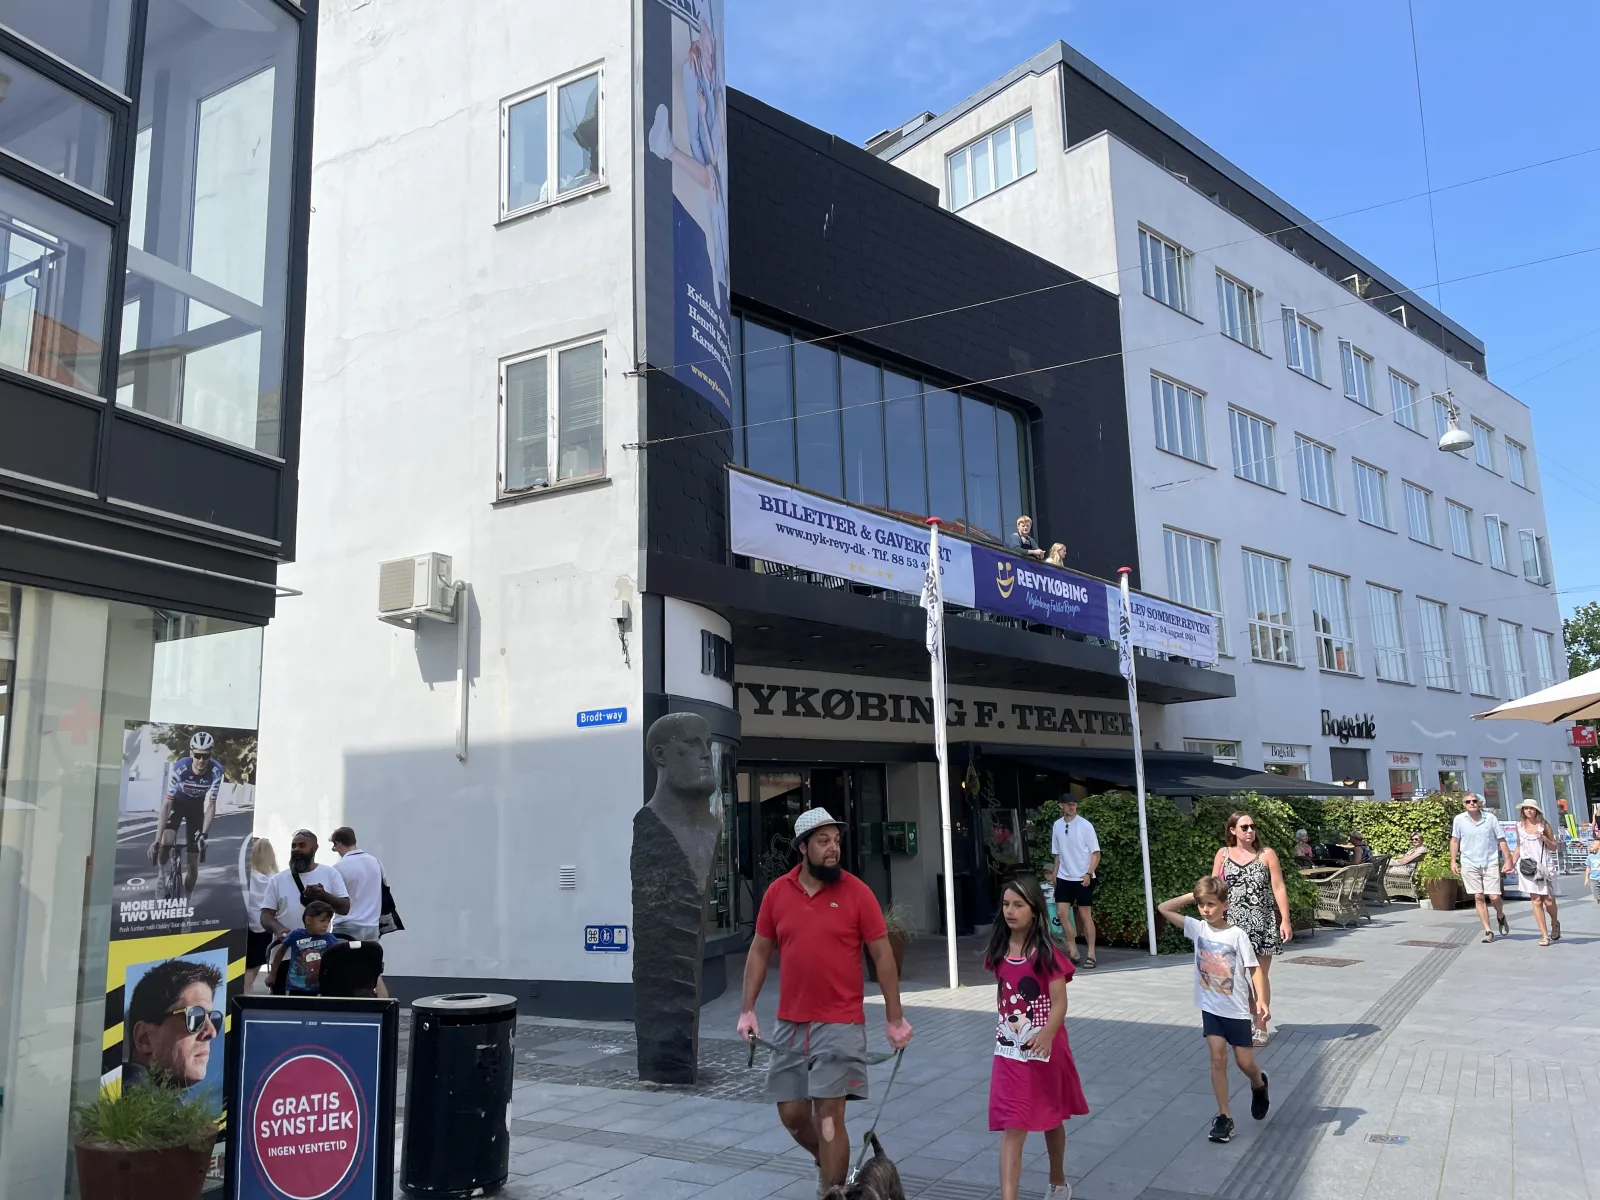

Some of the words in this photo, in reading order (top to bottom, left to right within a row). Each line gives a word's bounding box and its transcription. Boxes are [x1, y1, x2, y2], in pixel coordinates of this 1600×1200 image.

[686, 283, 719, 323] Kristine
[688, 304, 717, 339] Henrik
[691, 325, 722, 363] Karsten
[758, 493, 858, 537] BILLETTER
[859, 524, 873, 541] &
[891, 553, 905, 566] 88
[1016, 568, 1089, 604] REVYKØBING
[1146, 607, 1211, 635] SOMMERREVYEN
[580, 711, 623, 723] Brodt-way
[973, 700, 1006, 729] F.
[120, 899, 155, 912] MORE
[156, 898, 188, 910] THAN
[120, 910, 149, 923] TWO
[150, 906, 195, 920] WHEELS
[272, 1091, 340, 1117] GRATIS
[260, 1110, 354, 1138] SYNSTJEK
[267, 1143, 296, 1157] INGEN
[298, 1139, 347, 1155] VENTETID
